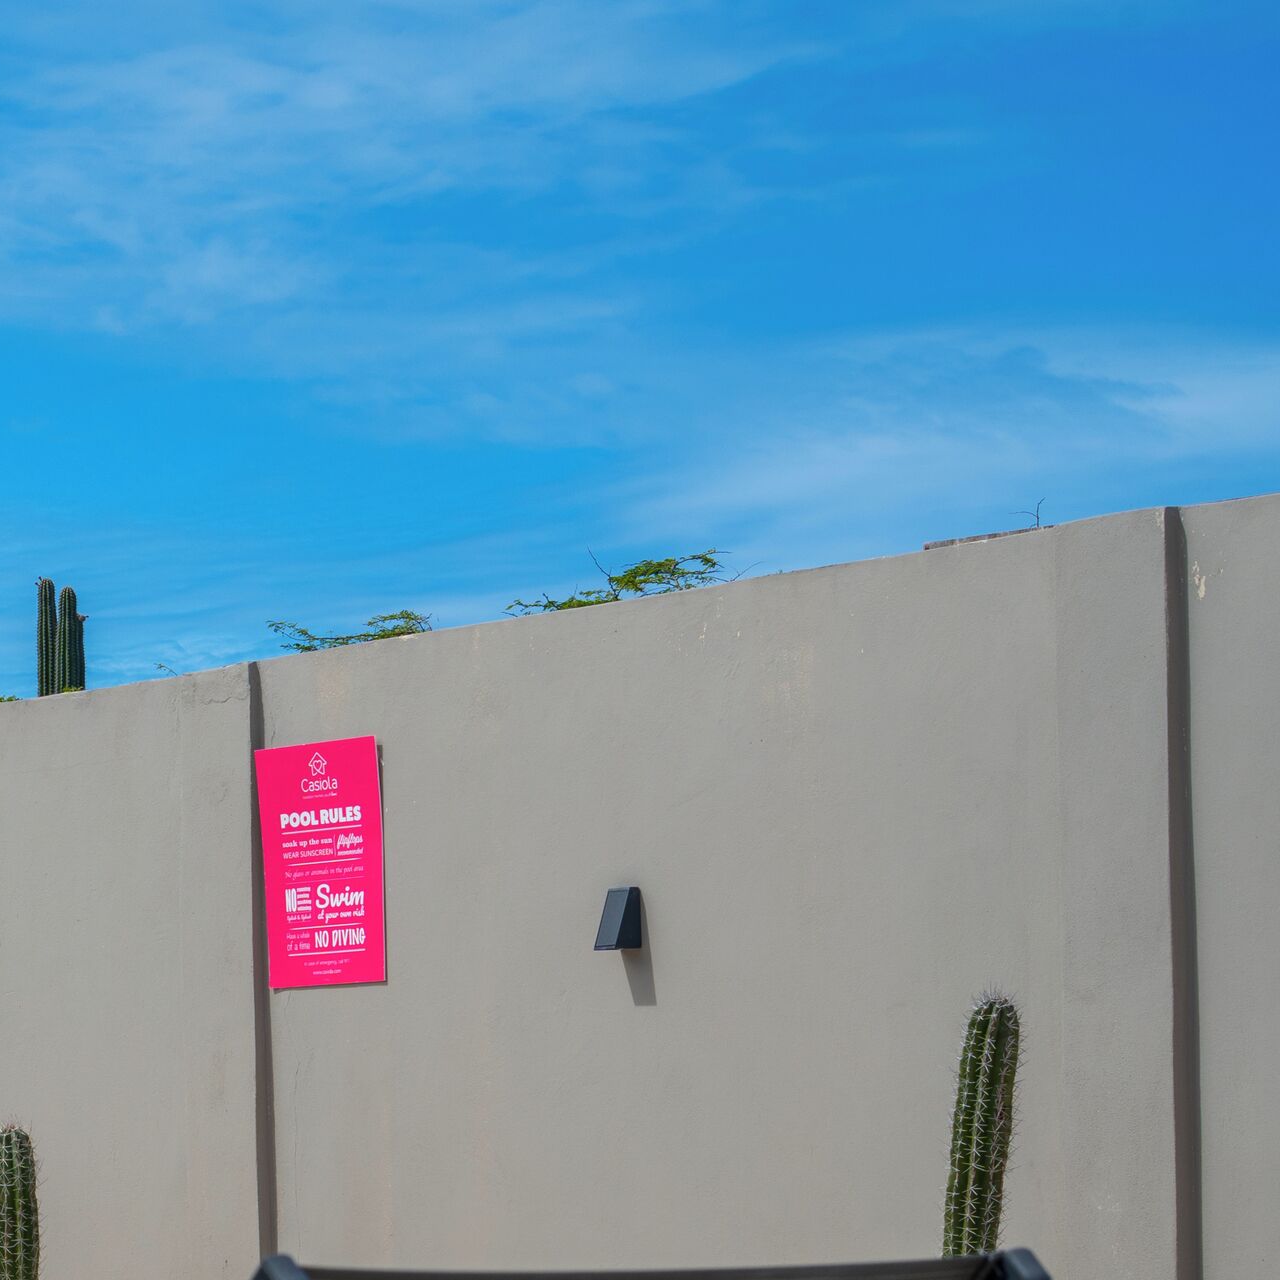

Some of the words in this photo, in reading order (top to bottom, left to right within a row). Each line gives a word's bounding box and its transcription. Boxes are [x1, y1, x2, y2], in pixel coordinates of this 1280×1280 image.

[301, 776, 338, 793] Casiola
[280, 813, 319, 829] POOL
[320, 805, 362, 825] RULES
[282, 840, 298, 848] soak
[299, 840, 308, 848] up
[309, 837, 320, 846] the
[282, 851, 300, 860] WEAR
[300, 847, 334, 858] SUNSCREEN
[285, 887, 297, 913] NO
[315, 883, 365, 909] Swim
[318, 908, 325, 920] at
[325, 912, 339, 924] your
[352, 904, 365, 917] risk
[314, 930, 329, 949] NO
[331, 927, 366, 948] DIVING
